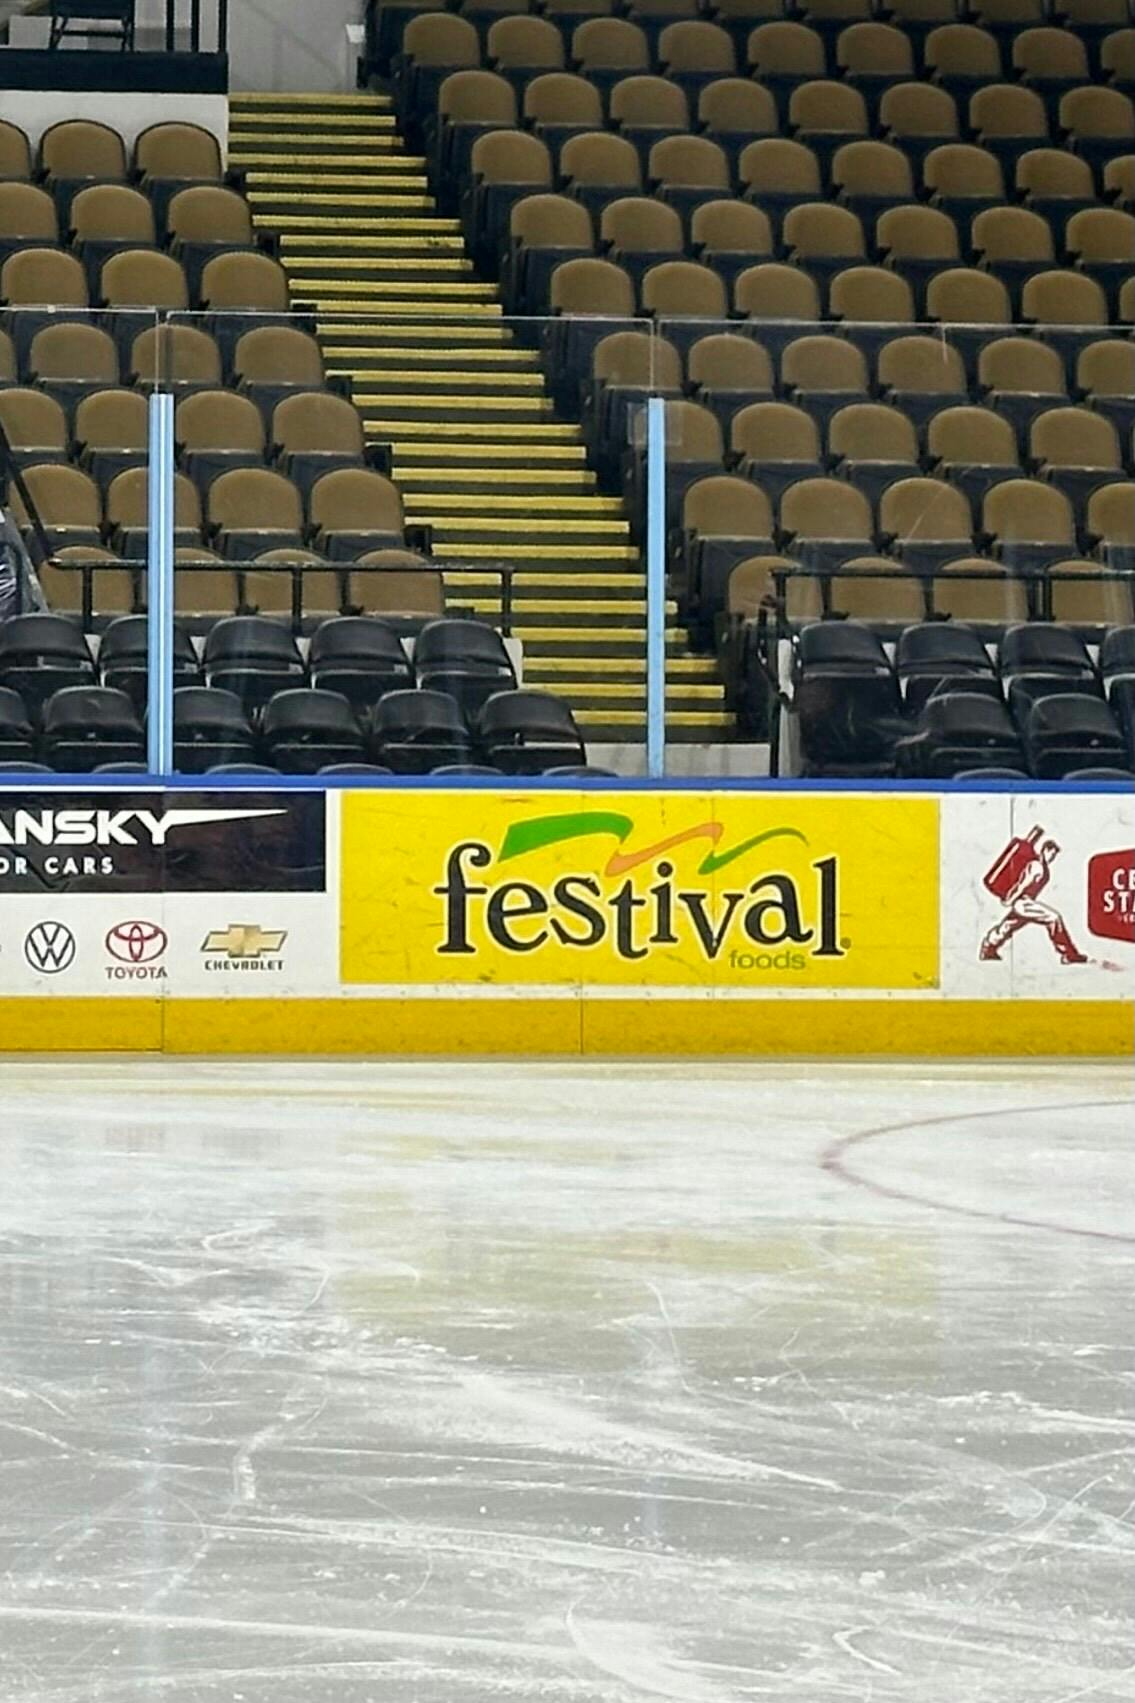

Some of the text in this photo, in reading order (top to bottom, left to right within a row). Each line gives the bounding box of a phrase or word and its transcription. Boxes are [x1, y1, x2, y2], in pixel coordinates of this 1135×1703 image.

[44, 857, 114, 875] CARS
[434, 842, 845, 959] festival
[1103, 890, 1135, 913] ST
[204, 960, 284, 970] CHEVROLET
[729, 950, 806, 970] foods
[105, 966, 168, 979] TOYOTA
